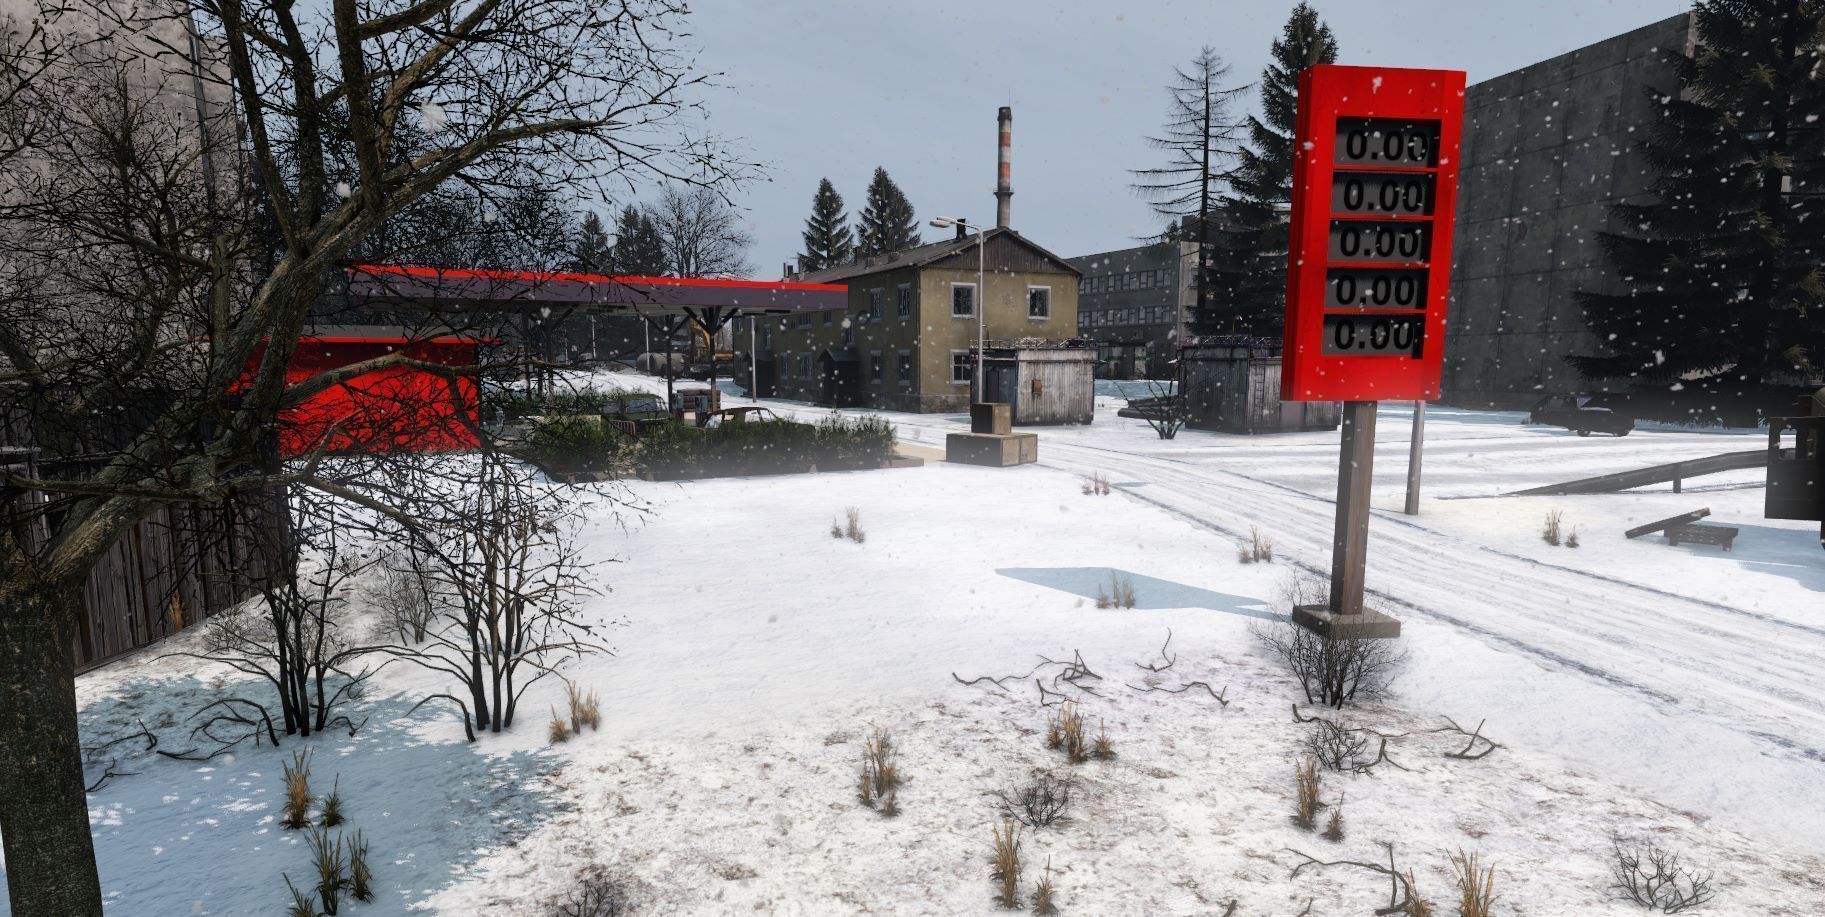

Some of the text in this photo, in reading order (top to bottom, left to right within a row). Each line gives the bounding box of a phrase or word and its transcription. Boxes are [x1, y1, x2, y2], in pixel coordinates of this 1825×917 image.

[1346, 129, 1428, 161] 0.00
[1344, 179, 1423, 212] 0.00
[1340, 226, 1419, 258] 0.00
[1336, 274, 1415, 306] 0.00
[1335, 319, 1414, 350] 0.00
